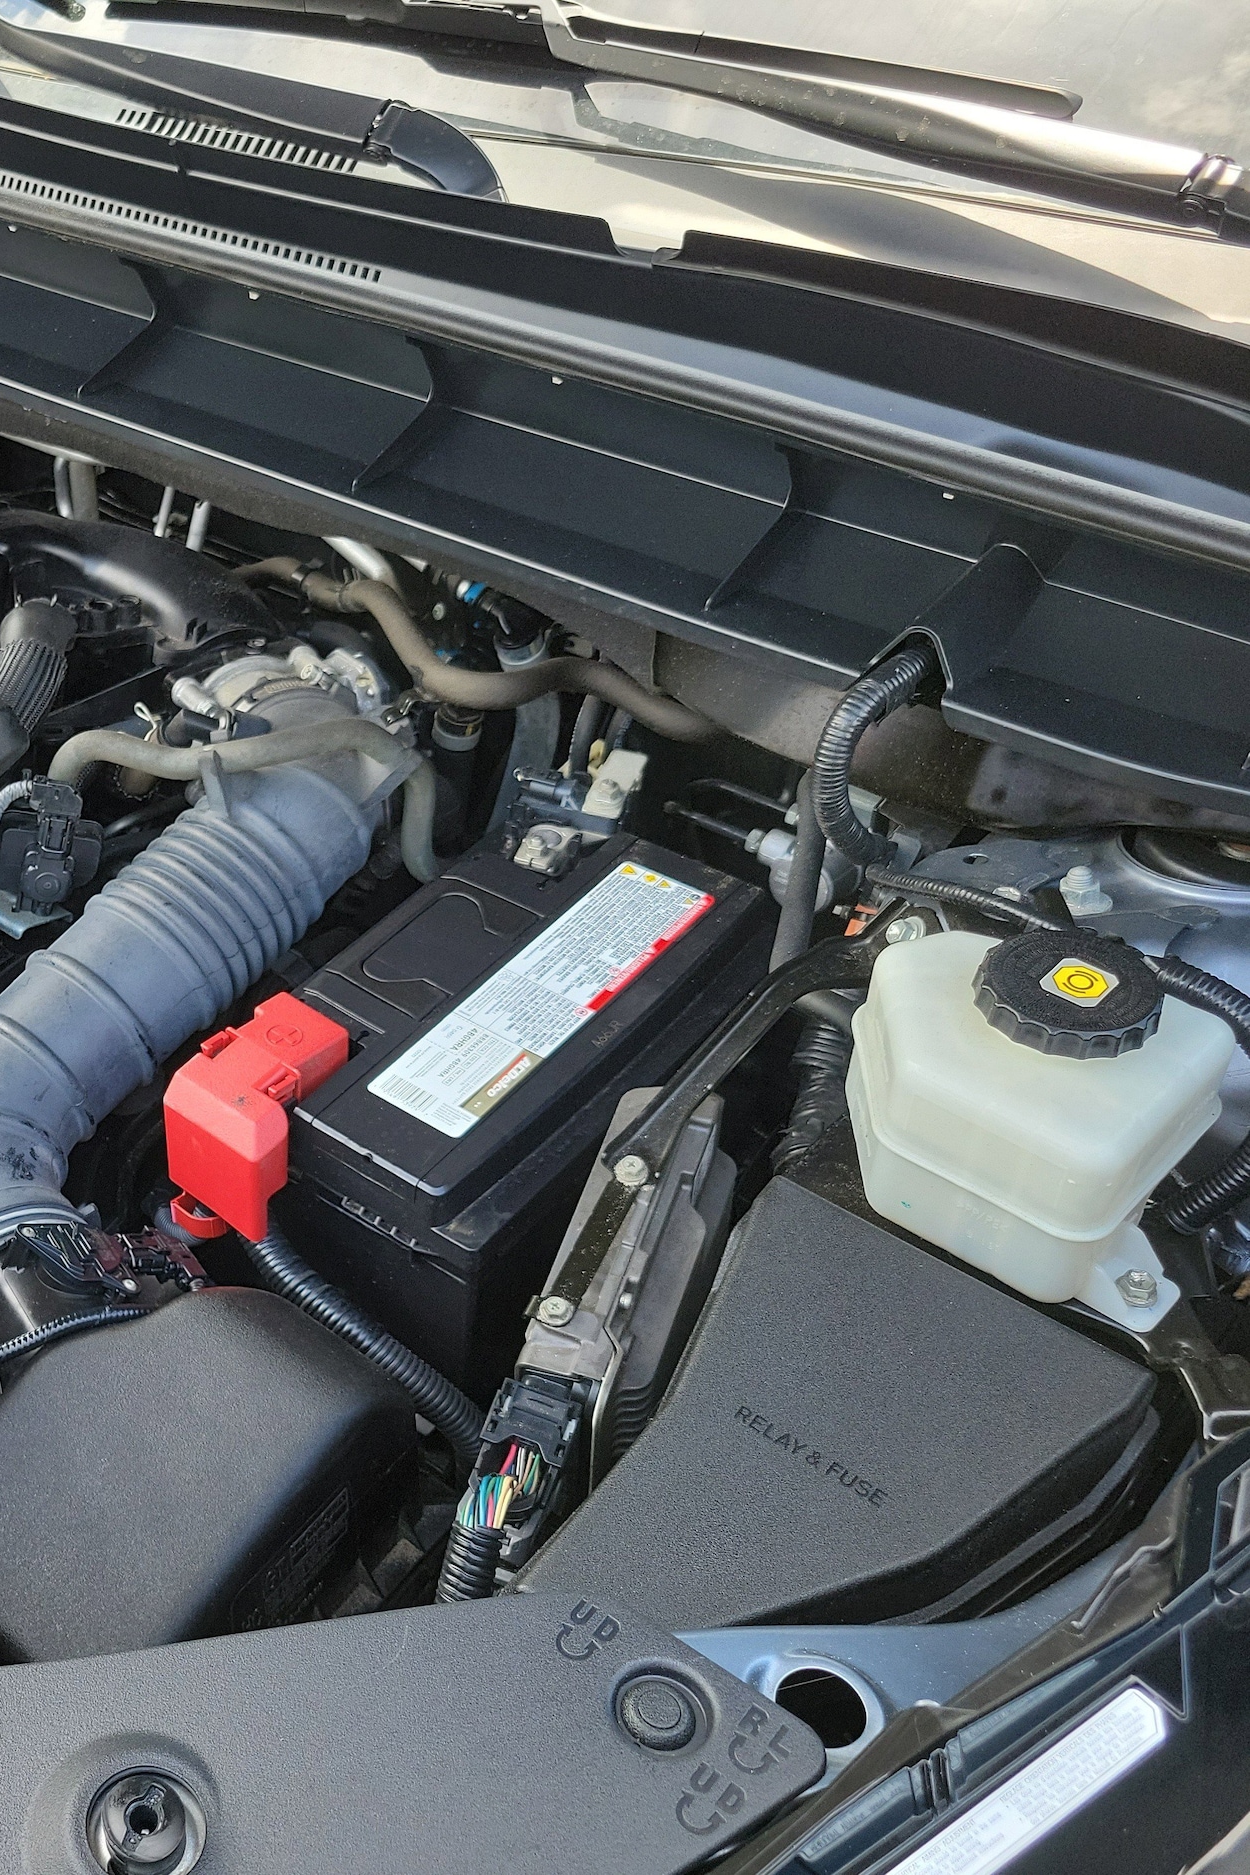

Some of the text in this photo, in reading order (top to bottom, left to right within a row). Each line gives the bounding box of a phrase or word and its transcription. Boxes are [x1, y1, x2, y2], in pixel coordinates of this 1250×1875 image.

[486, 1056, 531, 1098] ACDelco
[734, 1406, 888, 1507] RELAY & FUSE
